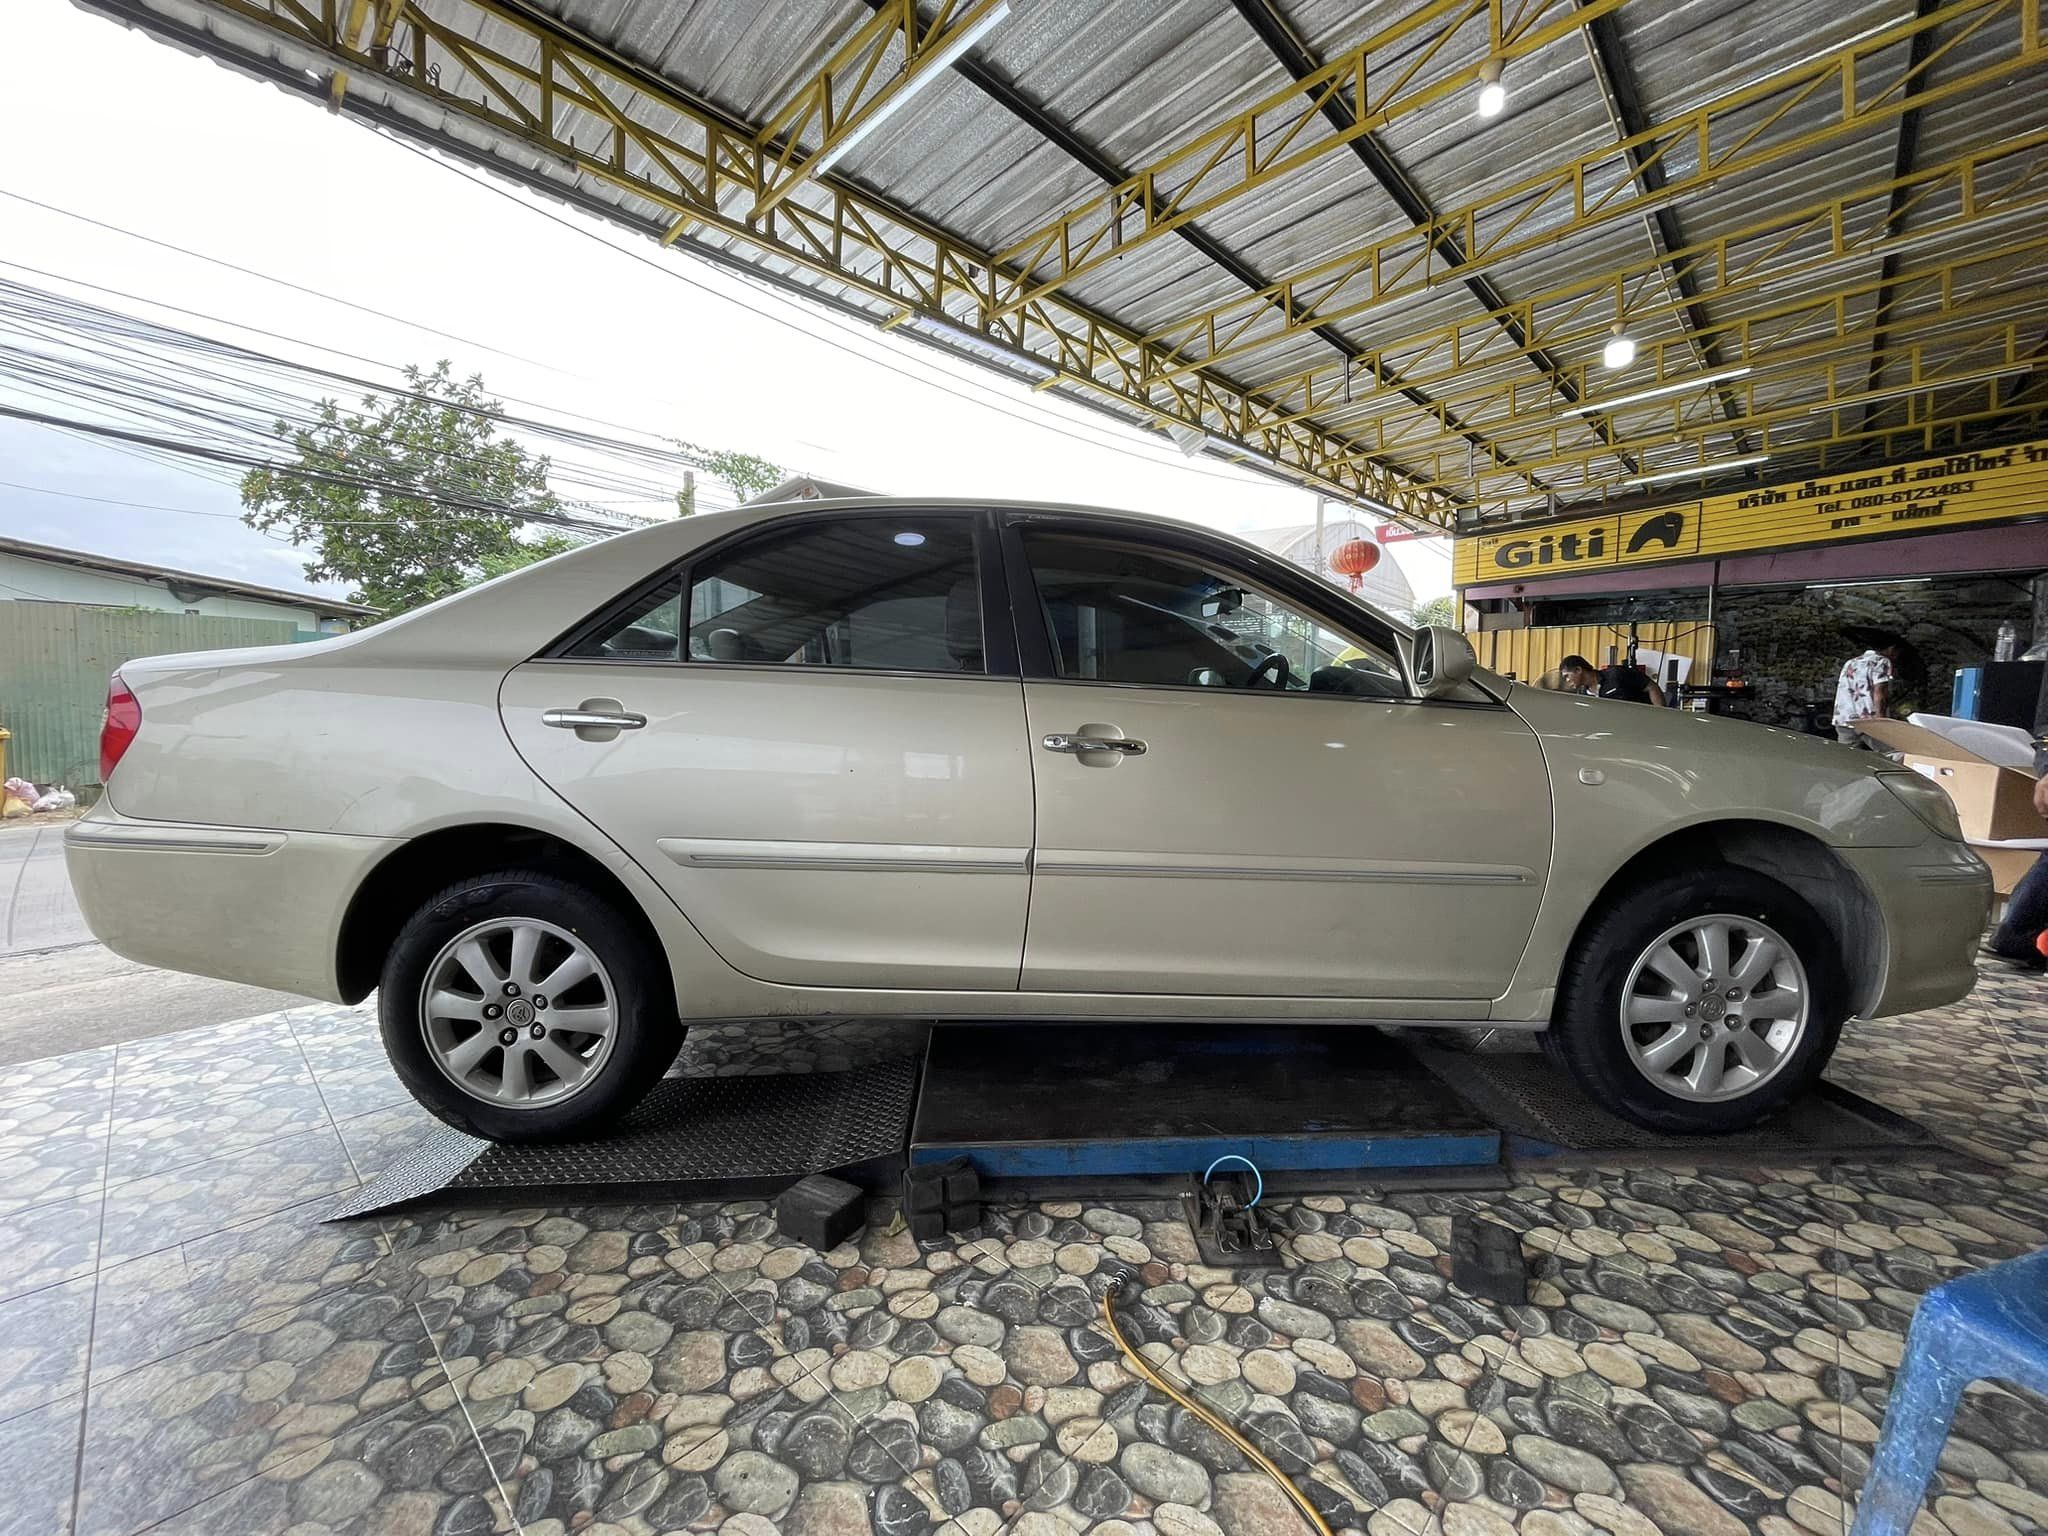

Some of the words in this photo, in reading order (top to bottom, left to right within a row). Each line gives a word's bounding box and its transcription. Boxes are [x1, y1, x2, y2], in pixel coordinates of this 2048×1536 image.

[1815, 500, 1845, 515] Tel.
[1851, 480, 1974, 509] 080-6123483
[1494, 528, 1606, 569] Giti
